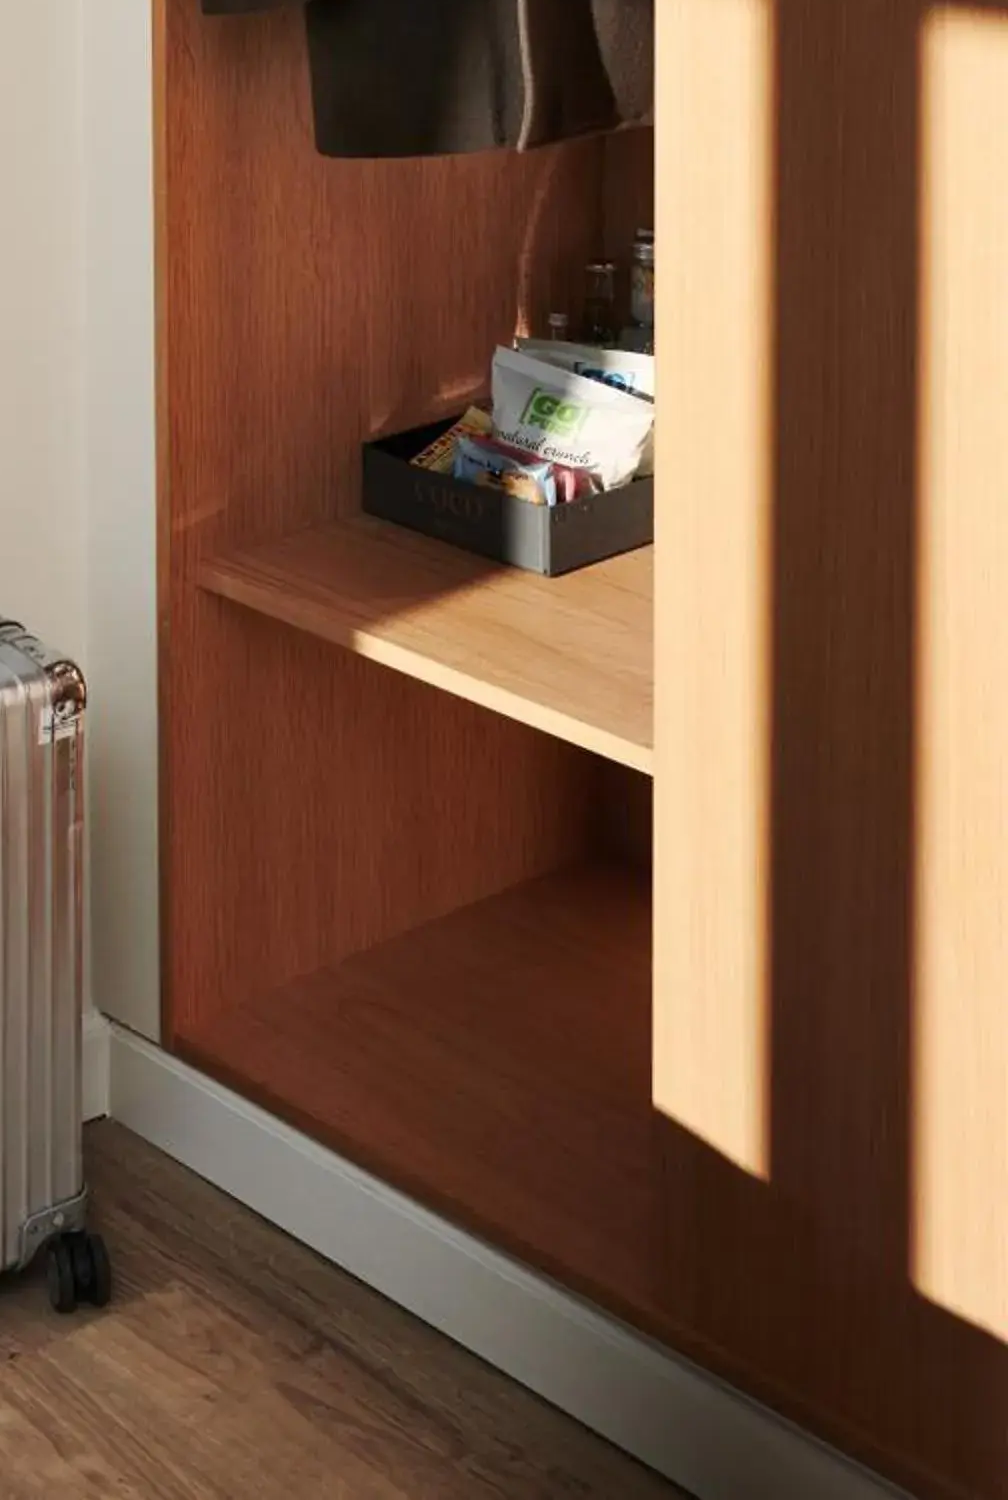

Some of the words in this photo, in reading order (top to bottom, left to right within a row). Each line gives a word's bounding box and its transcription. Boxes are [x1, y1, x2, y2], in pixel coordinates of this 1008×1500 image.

[533, 396, 581, 422] GO
[496, 430, 547, 451] natural
[544, 446, 591, 465] crunch
